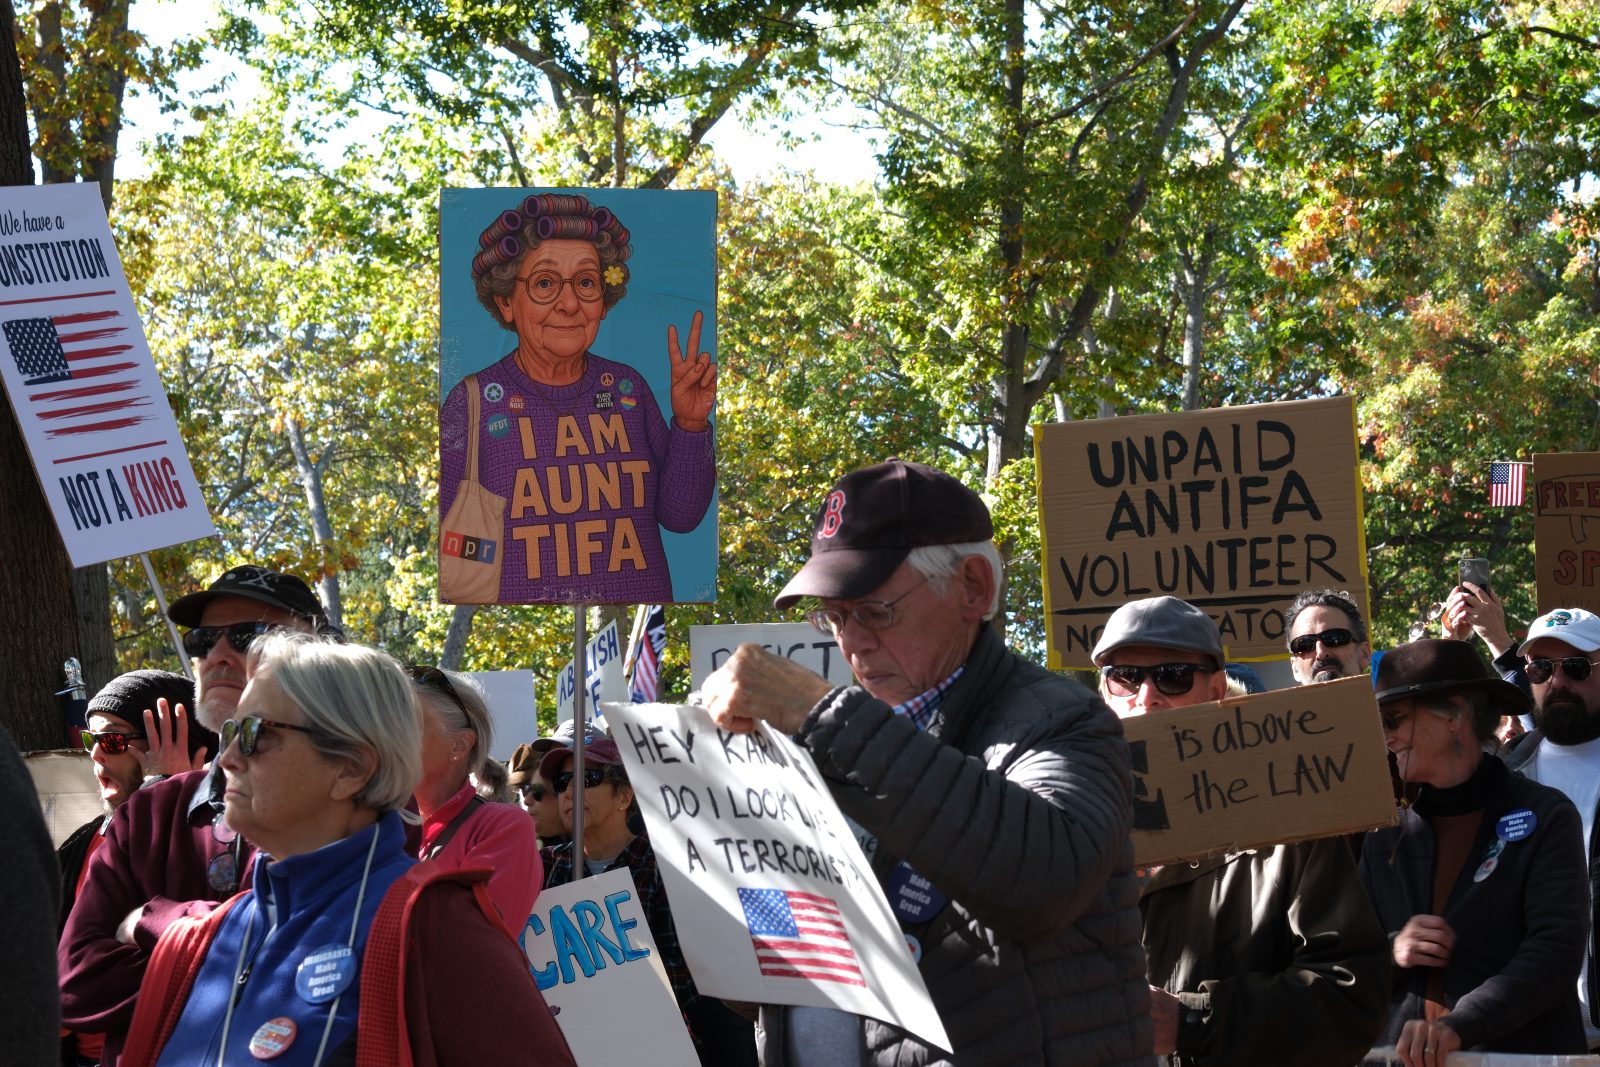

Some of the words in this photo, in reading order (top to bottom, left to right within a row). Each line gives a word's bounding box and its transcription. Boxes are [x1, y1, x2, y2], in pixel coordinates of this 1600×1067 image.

[0, 210, 21, 236] We
[23, 210, 53, 232] have
[55, 215, 65, 230] a
[518, 416, 537, 460] I
[555, 413, 631, 458] AM
[1087, 420, 1295, 488] UNPAID
[59, 471, 112, 530] NOT
[106, 468, 133, 521] A
[122, 456, 187, 517] KING
[510, 460, 650, 519] AUNT
[1105, 470, 1322, 541] ANTIFA
[817, 489, 846, 539] B
[446, 536, 493, 561] npr
[512, 517, 648, 580] TIFA
[1060, 534, 1346, 601] VOLUNTEER
[560, 625, 618, 707] ABLISH
[624, 722, 695, 764] HEY
[1171, 725, 1203, 761] is
[1213, 707, 1334, 754] above
[1185, 770, 1258, 814] the
[1268, 743, 1354, 796] LAW
[660, 784, 700, 821] DO
[706, 786, 720, 818] I
[1508, 818, 1524, 826] Make
[1505, 823, 1528, 833] America
[1509, 830, 1524, 838] Great
[687, 837, 706, 873] A
[899, 884, 931, 905] America
[908, 873, 931, 891] Make
[899, 899, 922, 916] Great
[518, 889, 650, 991] CARE
[308, 973, 341, 987] America
[315, 962, 337, 974] Make
[312, 984, 335, 997] Great
